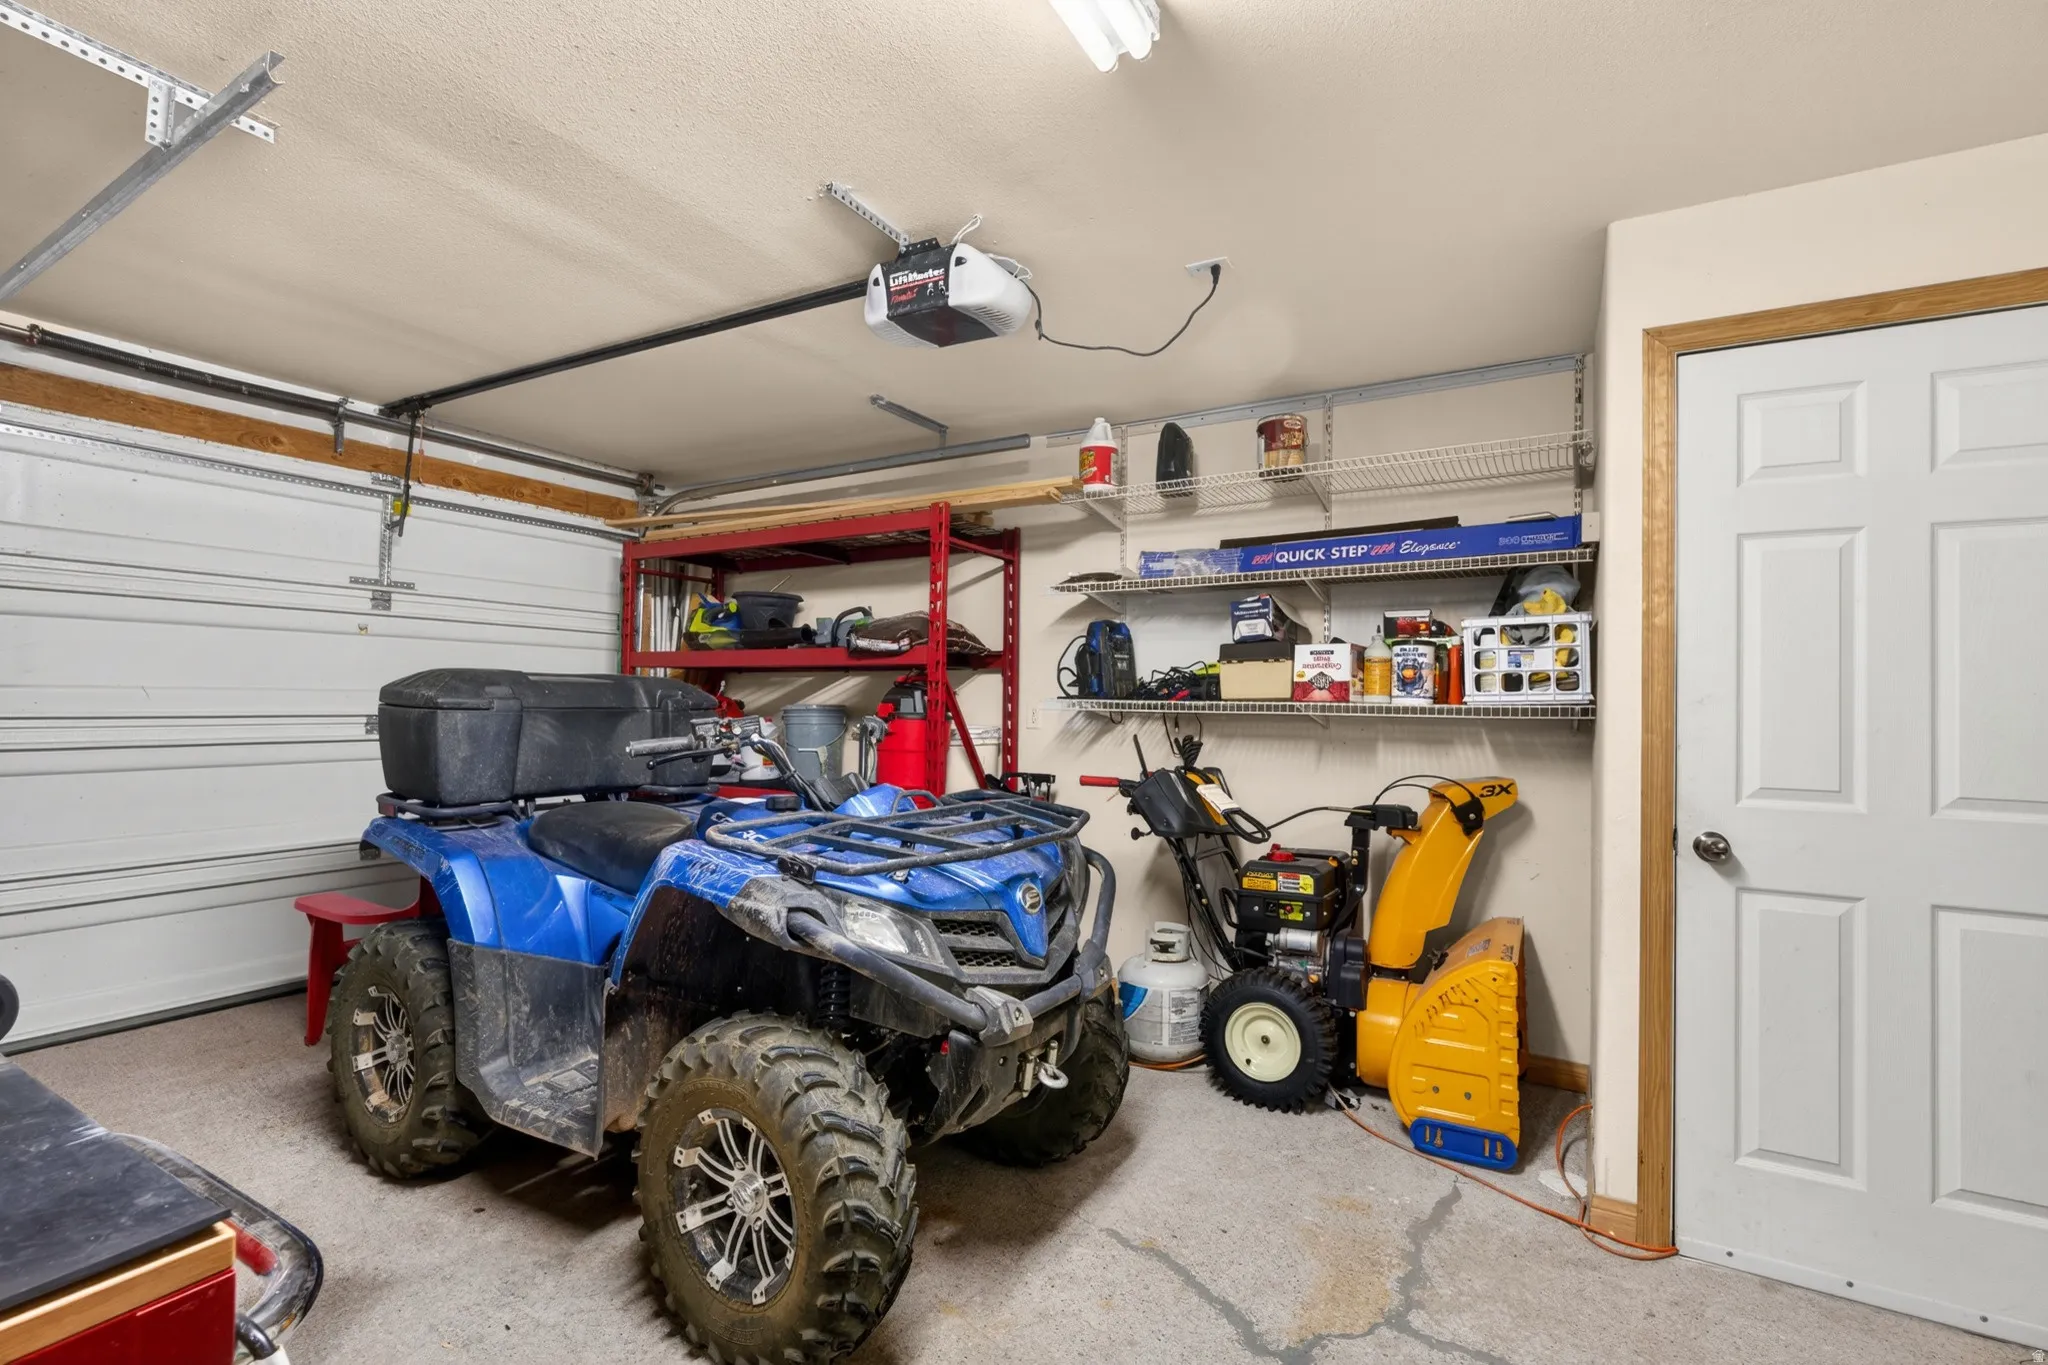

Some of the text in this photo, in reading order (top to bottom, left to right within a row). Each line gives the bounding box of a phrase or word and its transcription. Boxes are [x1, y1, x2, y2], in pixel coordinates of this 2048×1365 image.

[1275, 540, 1457, 564] QUICK STEP Elegance
[1479, 782, 1515, 798] 3X
